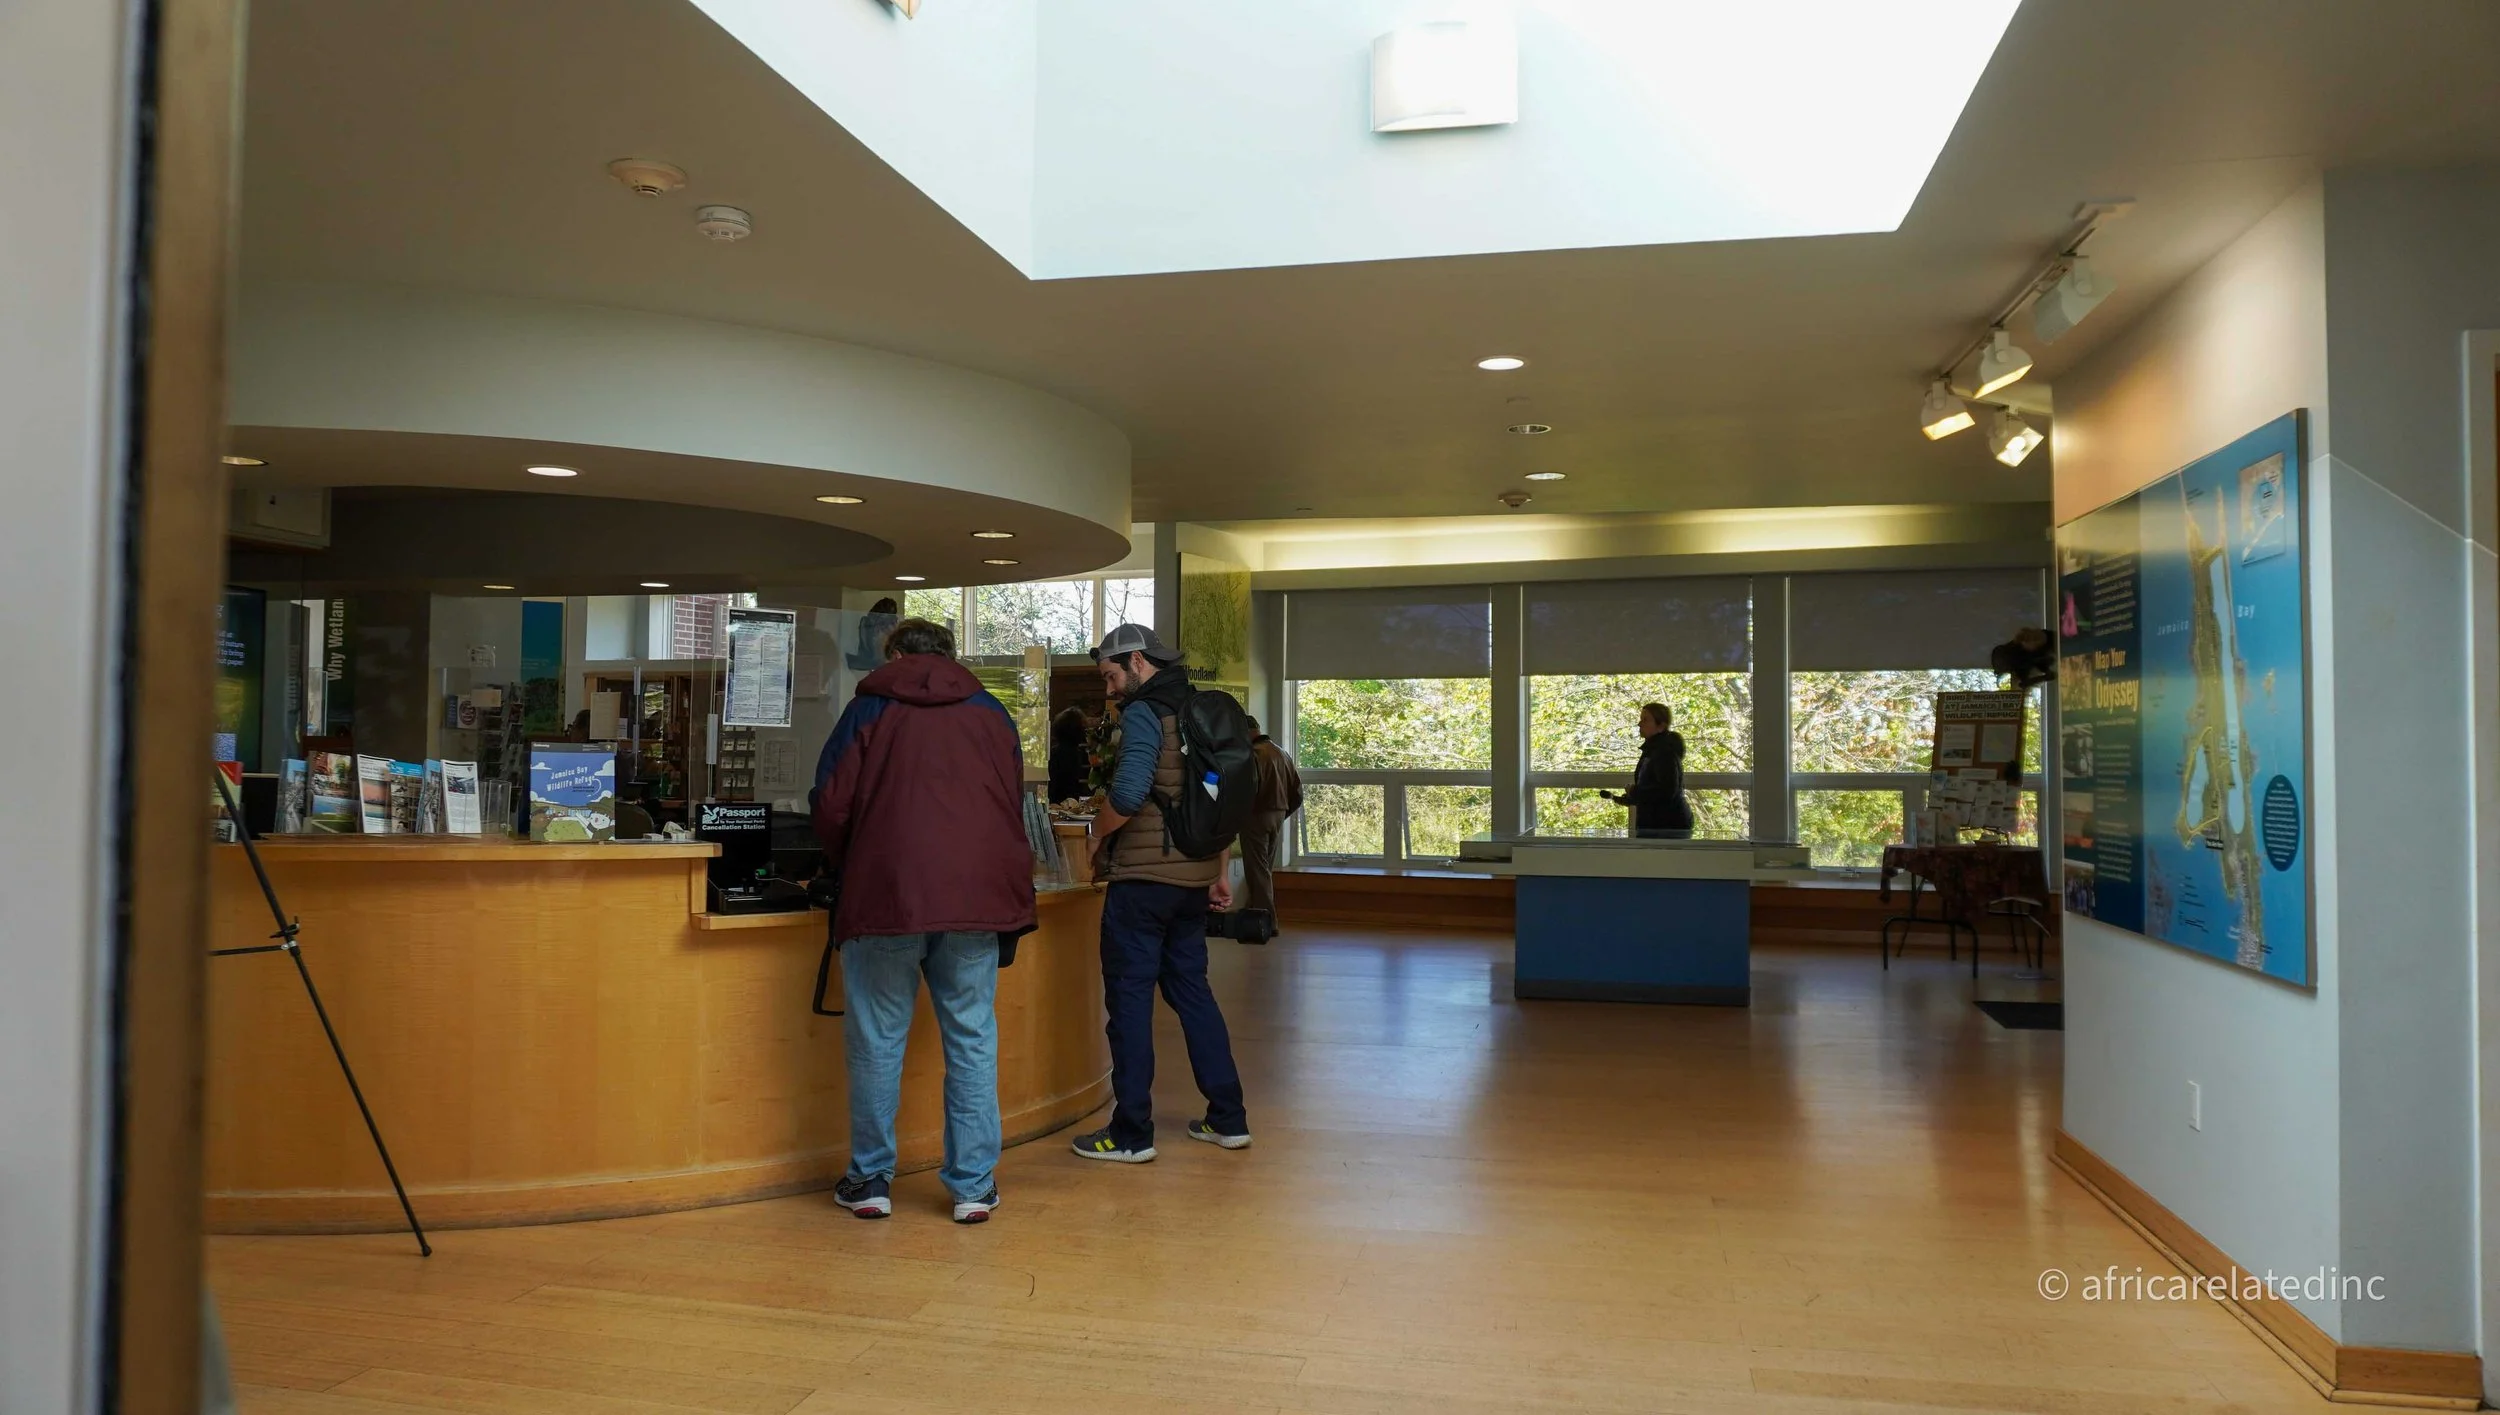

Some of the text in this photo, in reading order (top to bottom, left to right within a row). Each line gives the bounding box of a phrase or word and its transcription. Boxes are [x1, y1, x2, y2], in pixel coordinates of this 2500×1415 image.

[2237, 604, 2255, 619] Bay
[327, 598, 346, 681] Why Wetlan
[2095, 648, 2126, 673] Map Your
[2095, 678, 2139, 714] Odyssey
[551, 766, 588, 780] Jamaica Bay
[546, 779, 573, 792] Wildlife
[574, 775, 595, 786] Refuge
[719, 807, 766, 818] Passport
